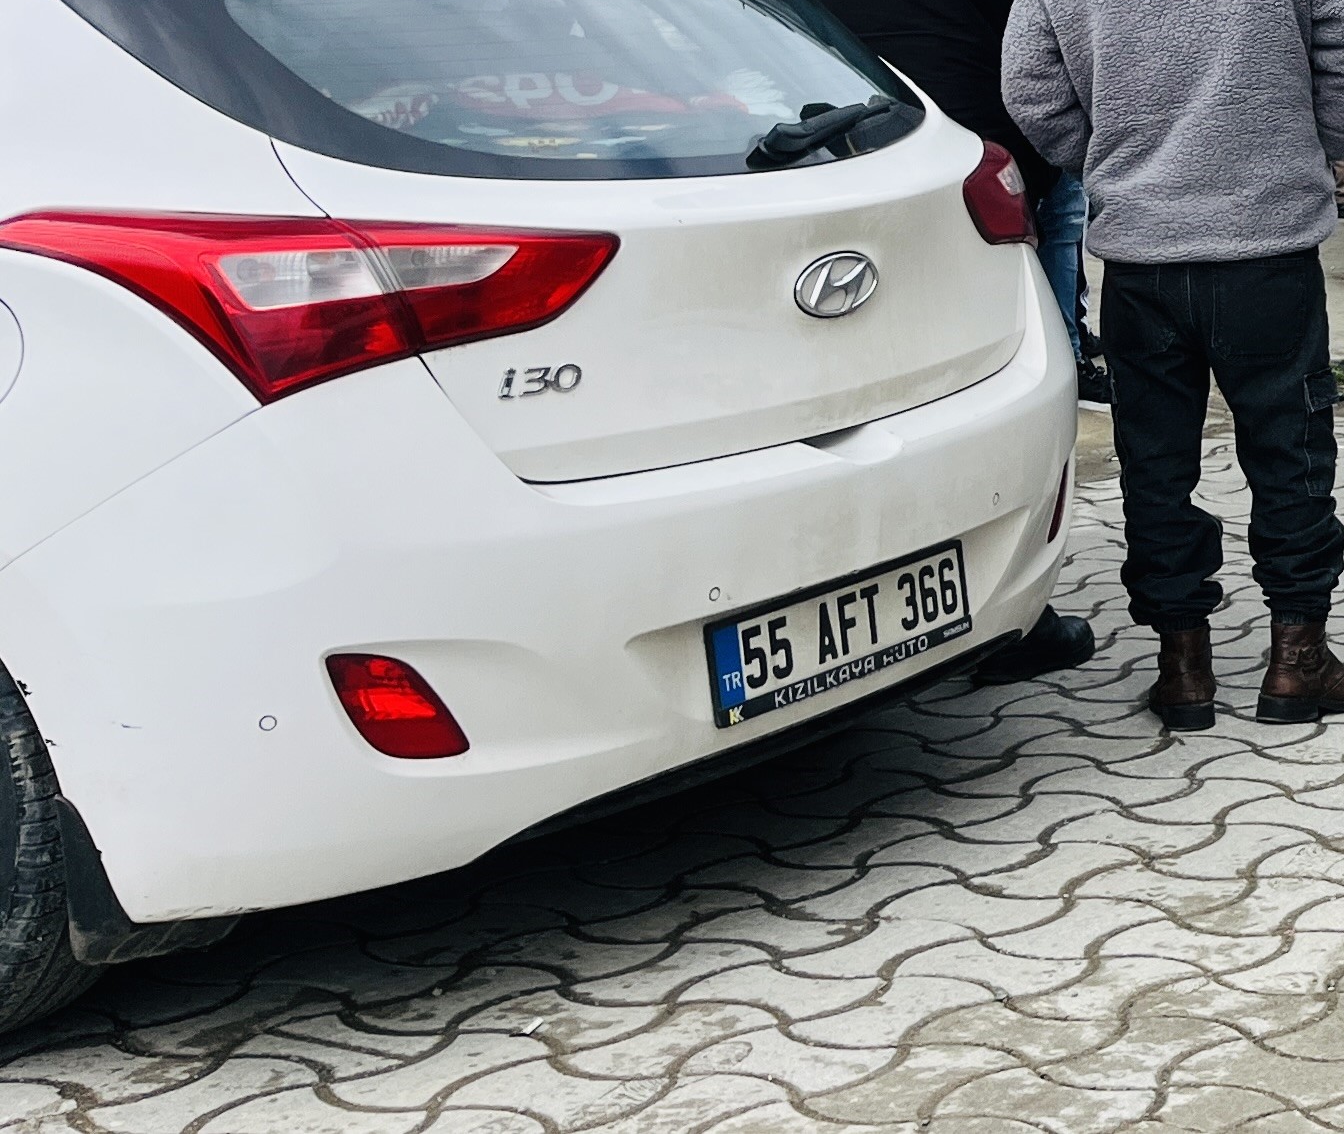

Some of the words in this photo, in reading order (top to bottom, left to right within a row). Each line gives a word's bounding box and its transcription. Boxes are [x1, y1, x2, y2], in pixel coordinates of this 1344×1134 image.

[497, 363, 583, 400] i30
[740, 615, 794, 690] 55
[818, 583, 879, 666] AFT
[897, 557, 958, 632] 366
[722, 671, 742, 692] TR
[774, 655, 876, 708] KIZILKAYA
